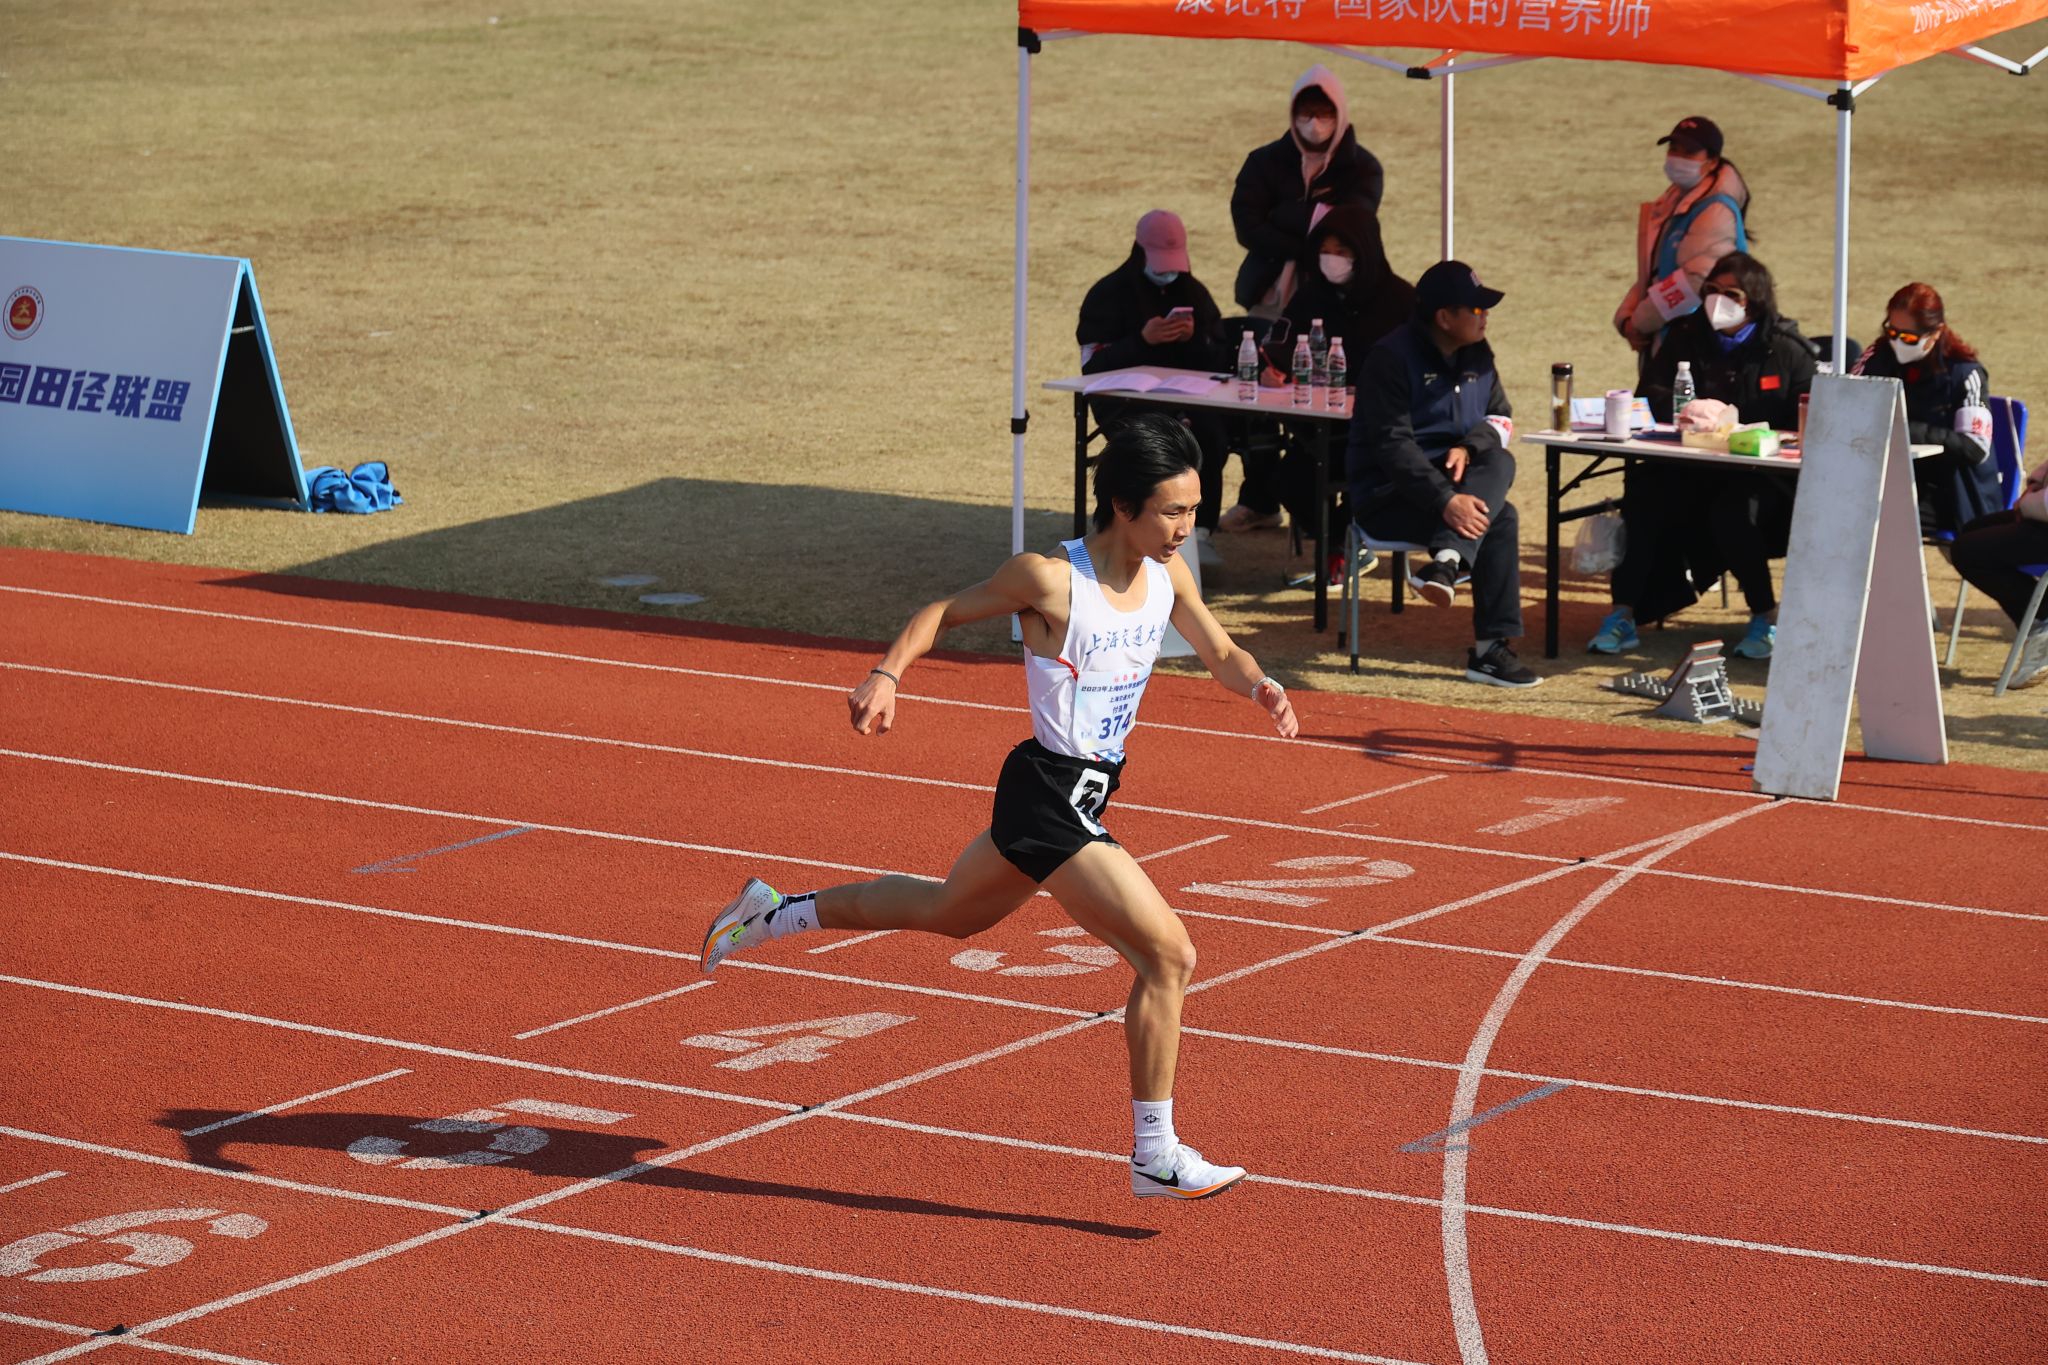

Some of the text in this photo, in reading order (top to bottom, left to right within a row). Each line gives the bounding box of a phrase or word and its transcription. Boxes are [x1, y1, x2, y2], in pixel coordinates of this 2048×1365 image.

[0, 361, 191, 422] 园田径联盟
[1098, 711, 1132, 740] 374
[1476, 795, 1625, 836] 1
[1180, 856, 1415, 908] 2
[950, 926, 1120, 977] 3
[681, 1012, 918, 1071] 4
[347, 1099, 635, 1170] 5
[0, 1208, 268, 1283] 6
